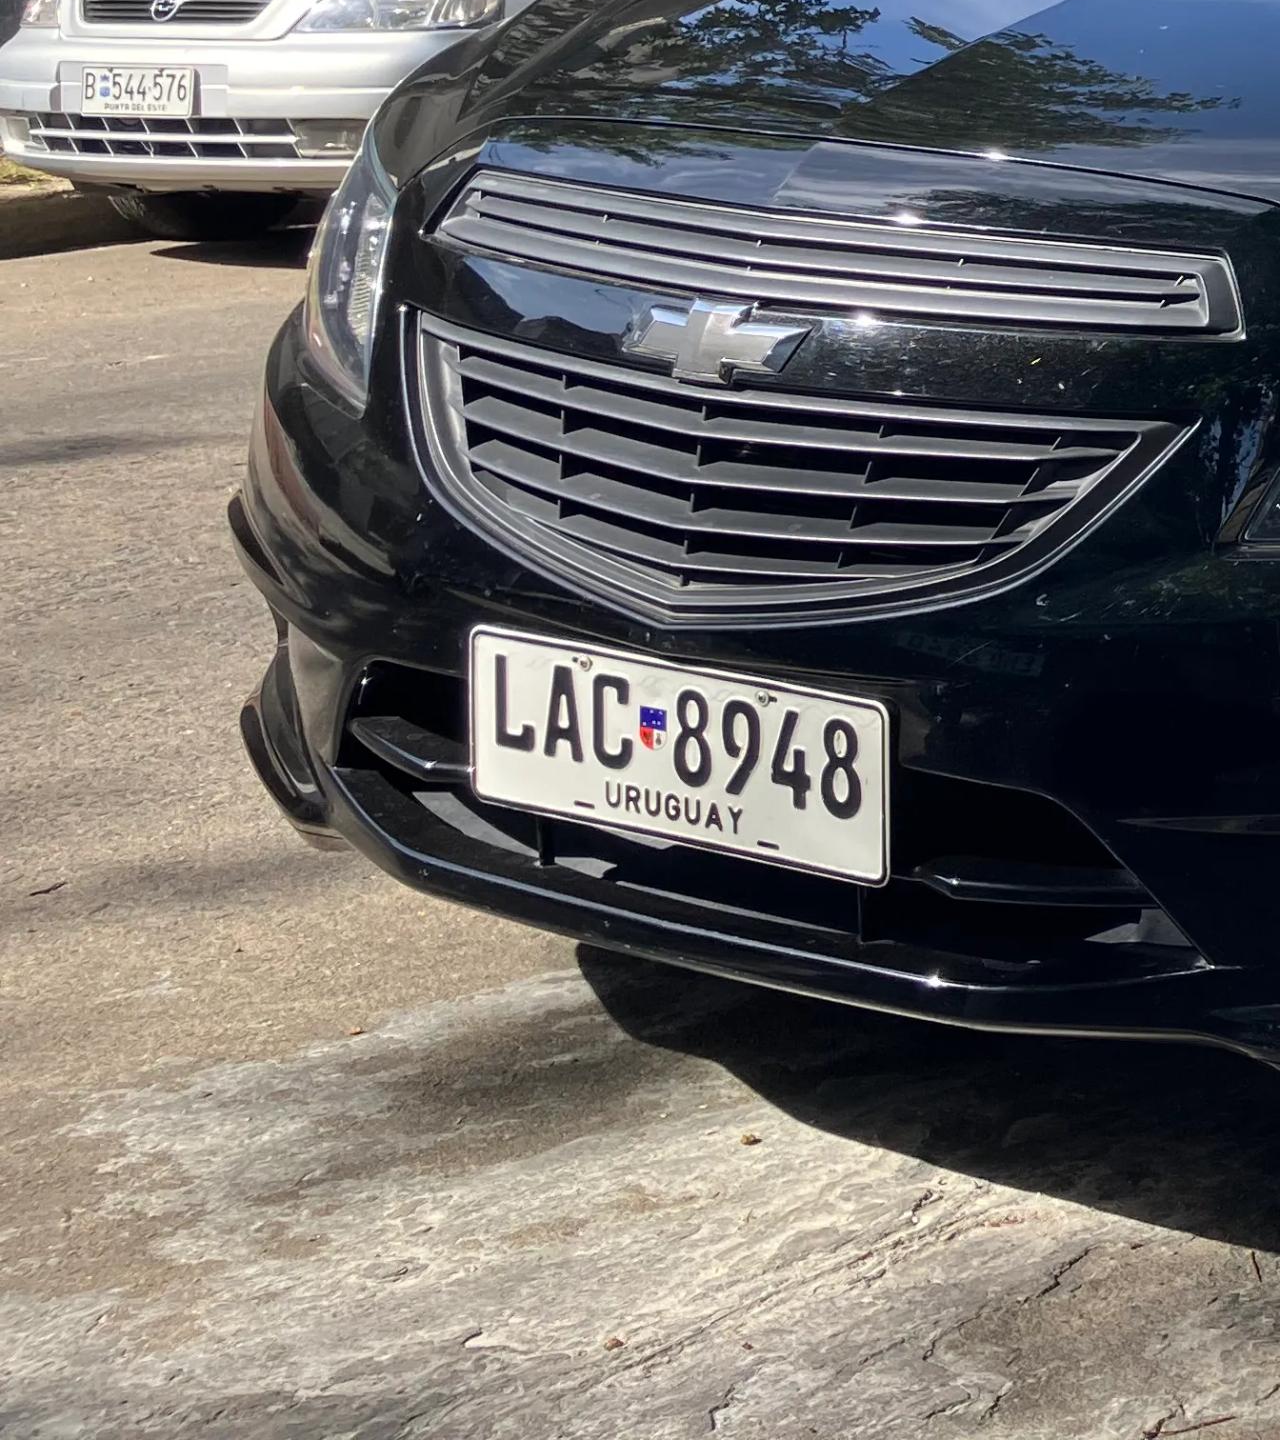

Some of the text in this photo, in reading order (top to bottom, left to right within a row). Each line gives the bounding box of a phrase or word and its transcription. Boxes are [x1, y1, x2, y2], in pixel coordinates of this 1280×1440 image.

[85, 72, 96, 100] B
[495, 653, 863, 820] LAC 8948
[605, 781, 744, 835] URUGUAY
